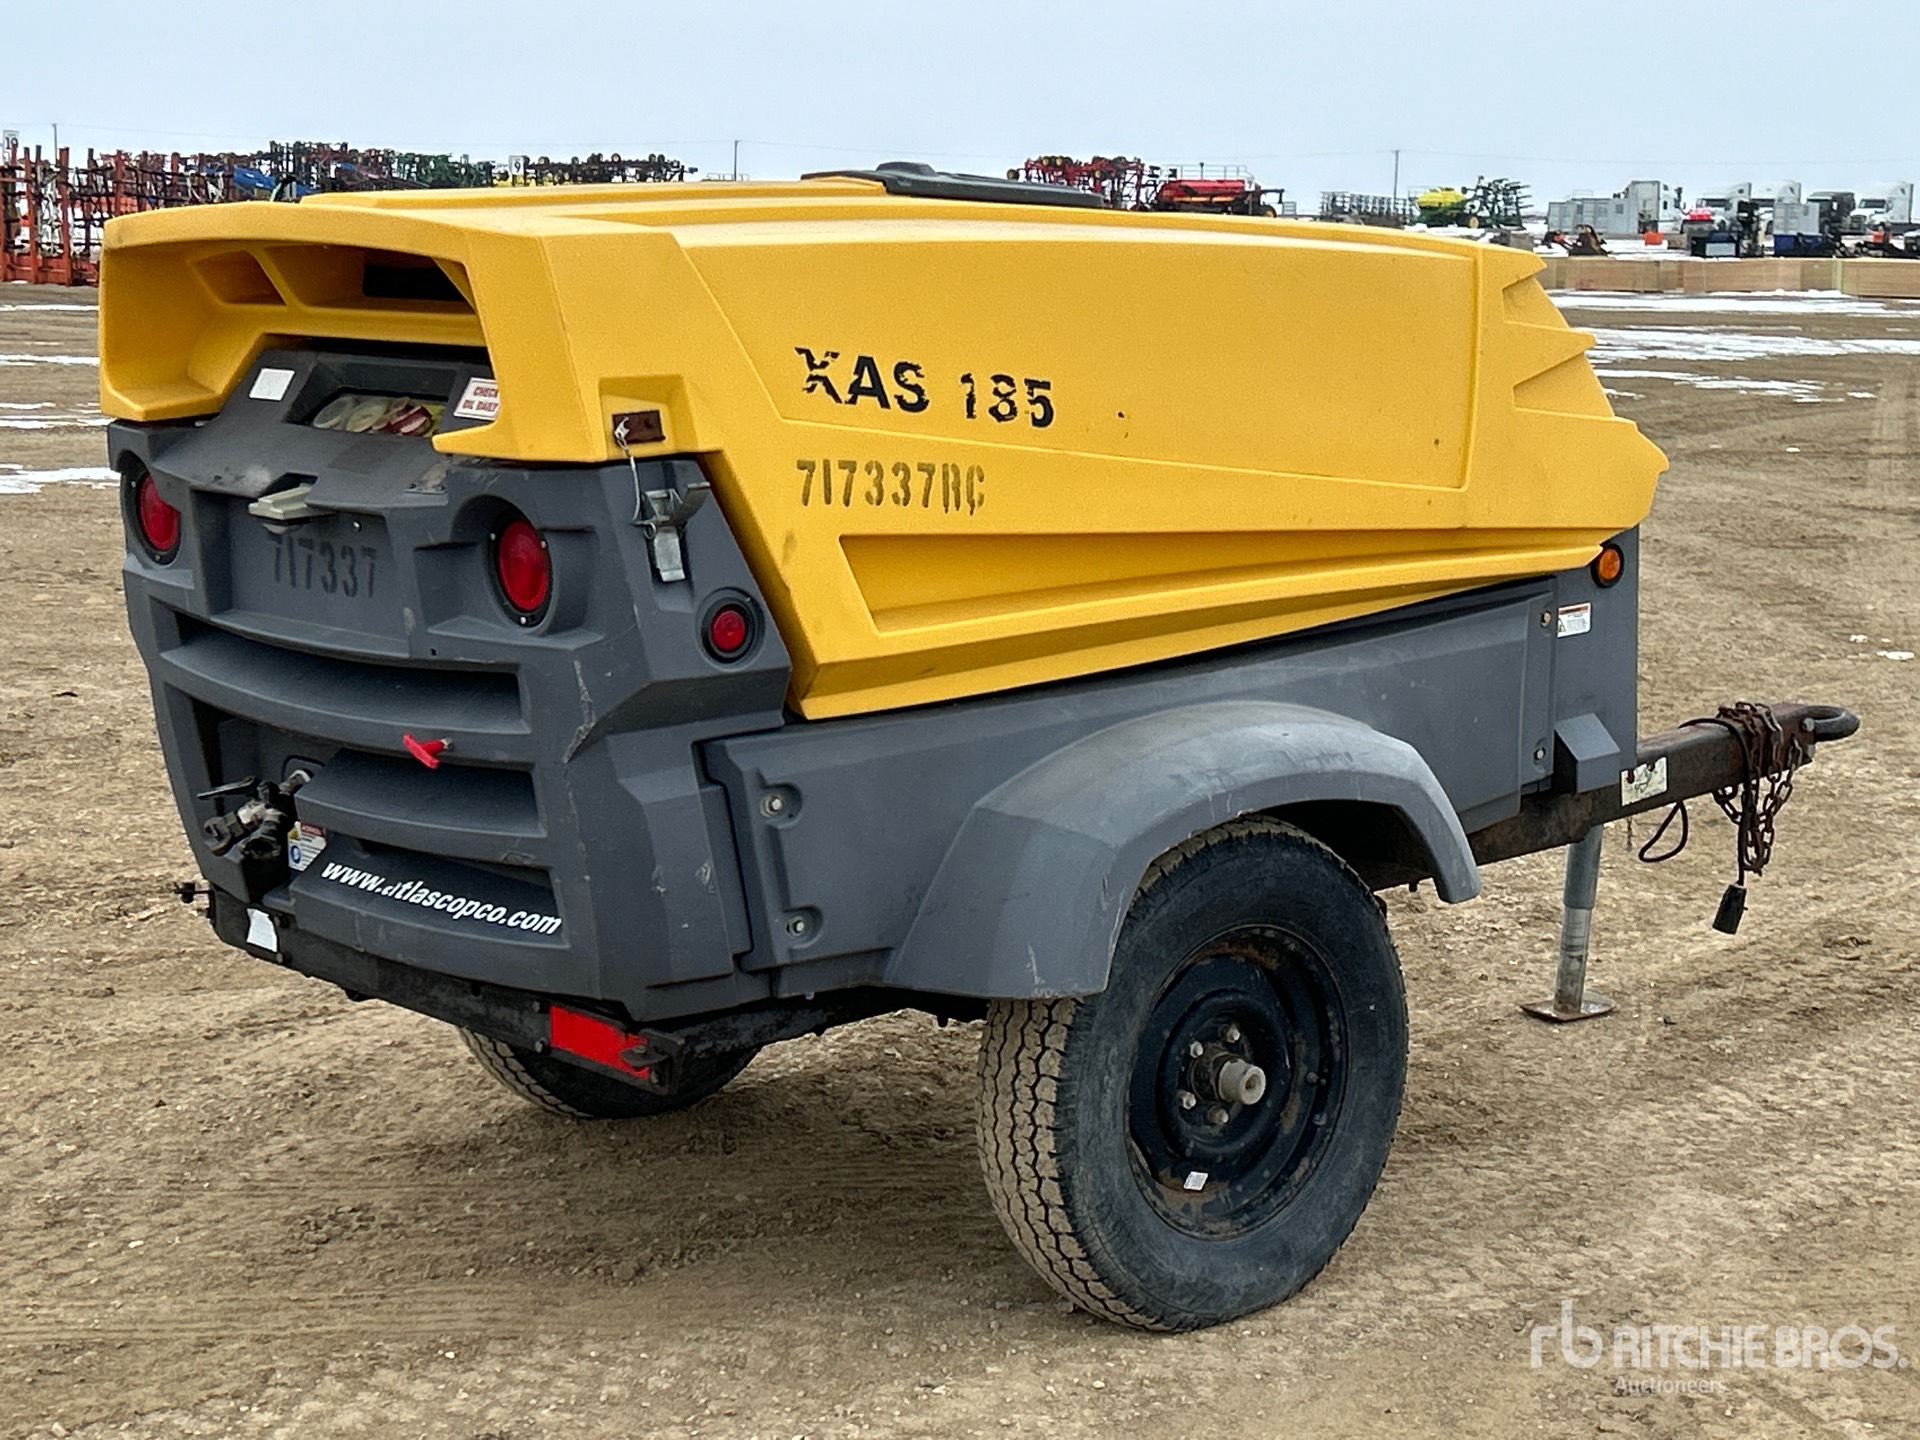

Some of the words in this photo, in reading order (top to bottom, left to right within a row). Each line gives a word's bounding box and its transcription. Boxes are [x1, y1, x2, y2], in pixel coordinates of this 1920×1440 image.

[794, 346, 930, 413] XAS
[960, 372, 1055, 428] 185
[796, 458, 986, 517] 717337RC
[267, 532, 378, 599] 717337
